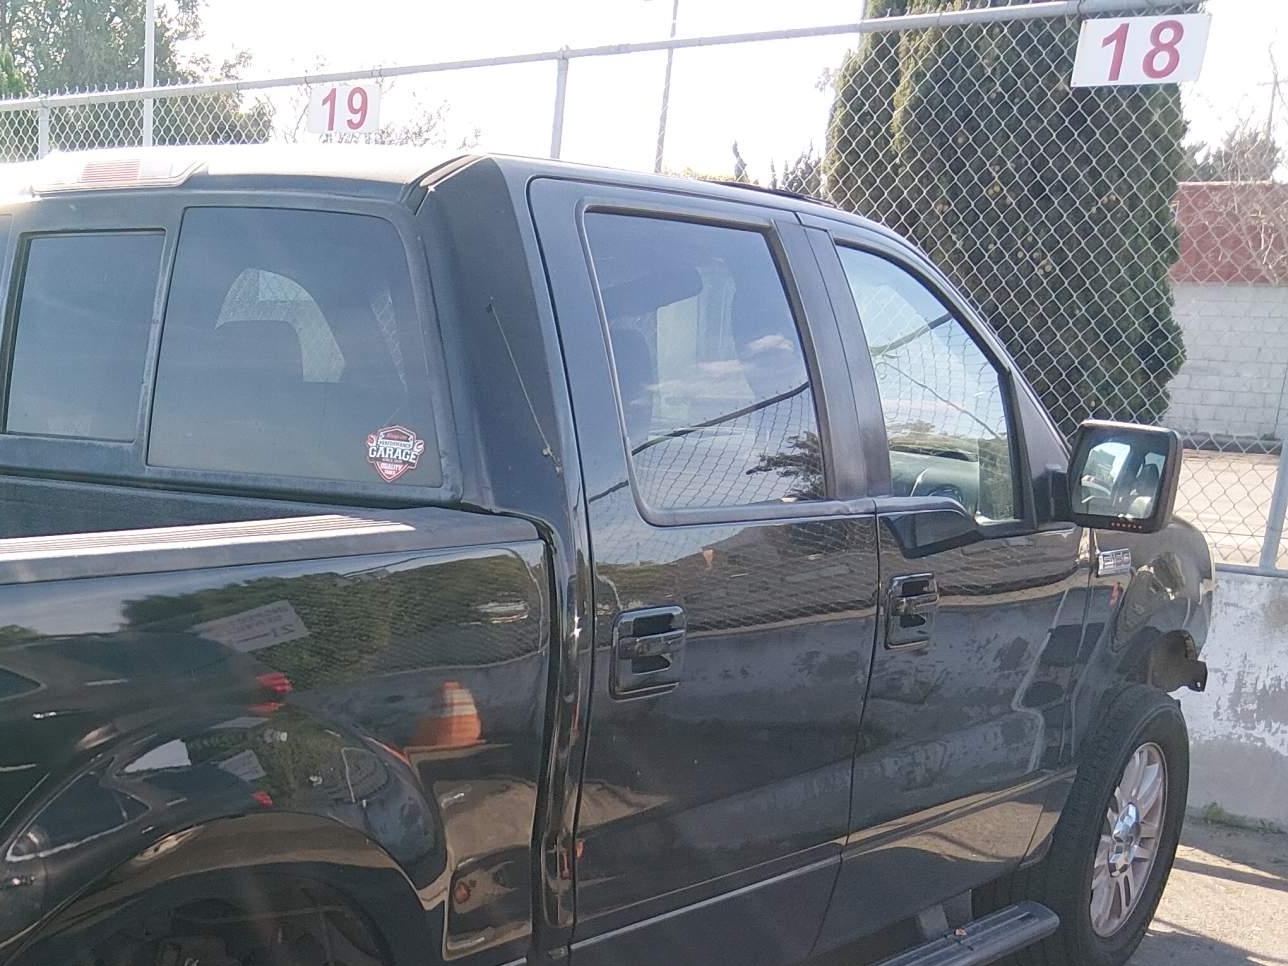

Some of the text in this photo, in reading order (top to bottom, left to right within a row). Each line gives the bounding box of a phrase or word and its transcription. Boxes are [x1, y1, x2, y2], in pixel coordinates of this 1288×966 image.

[1101, 19, 1185, 82] 18
[321, 86, 369, 131] 19
[368, 446, 418, 464] GARAGE
